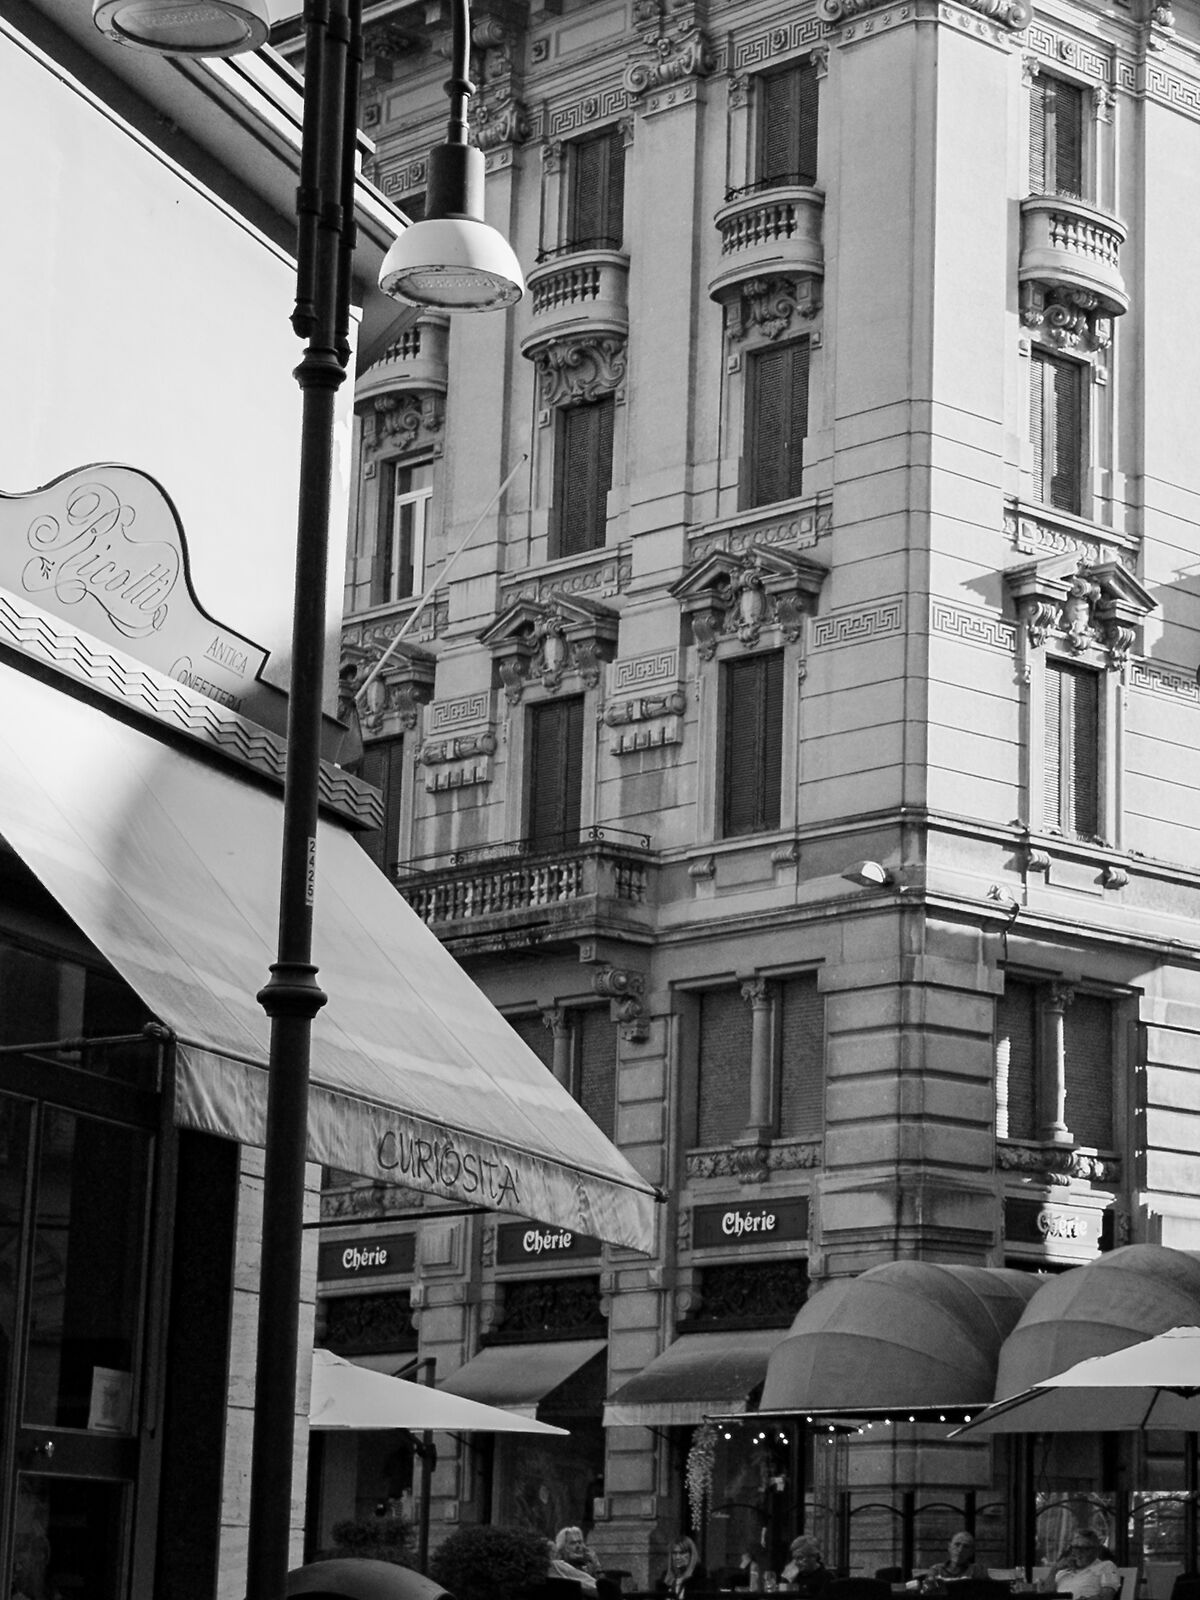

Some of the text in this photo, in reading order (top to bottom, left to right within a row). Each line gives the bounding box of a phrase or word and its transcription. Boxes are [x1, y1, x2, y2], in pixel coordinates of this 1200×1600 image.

[205, 635, 249, 674] ANTICA
[722, 1210, 776, 1237] Chérie
[522, 1228, 572, 1255] Chérie
[342, 1246, 388, 1271] Chérie
